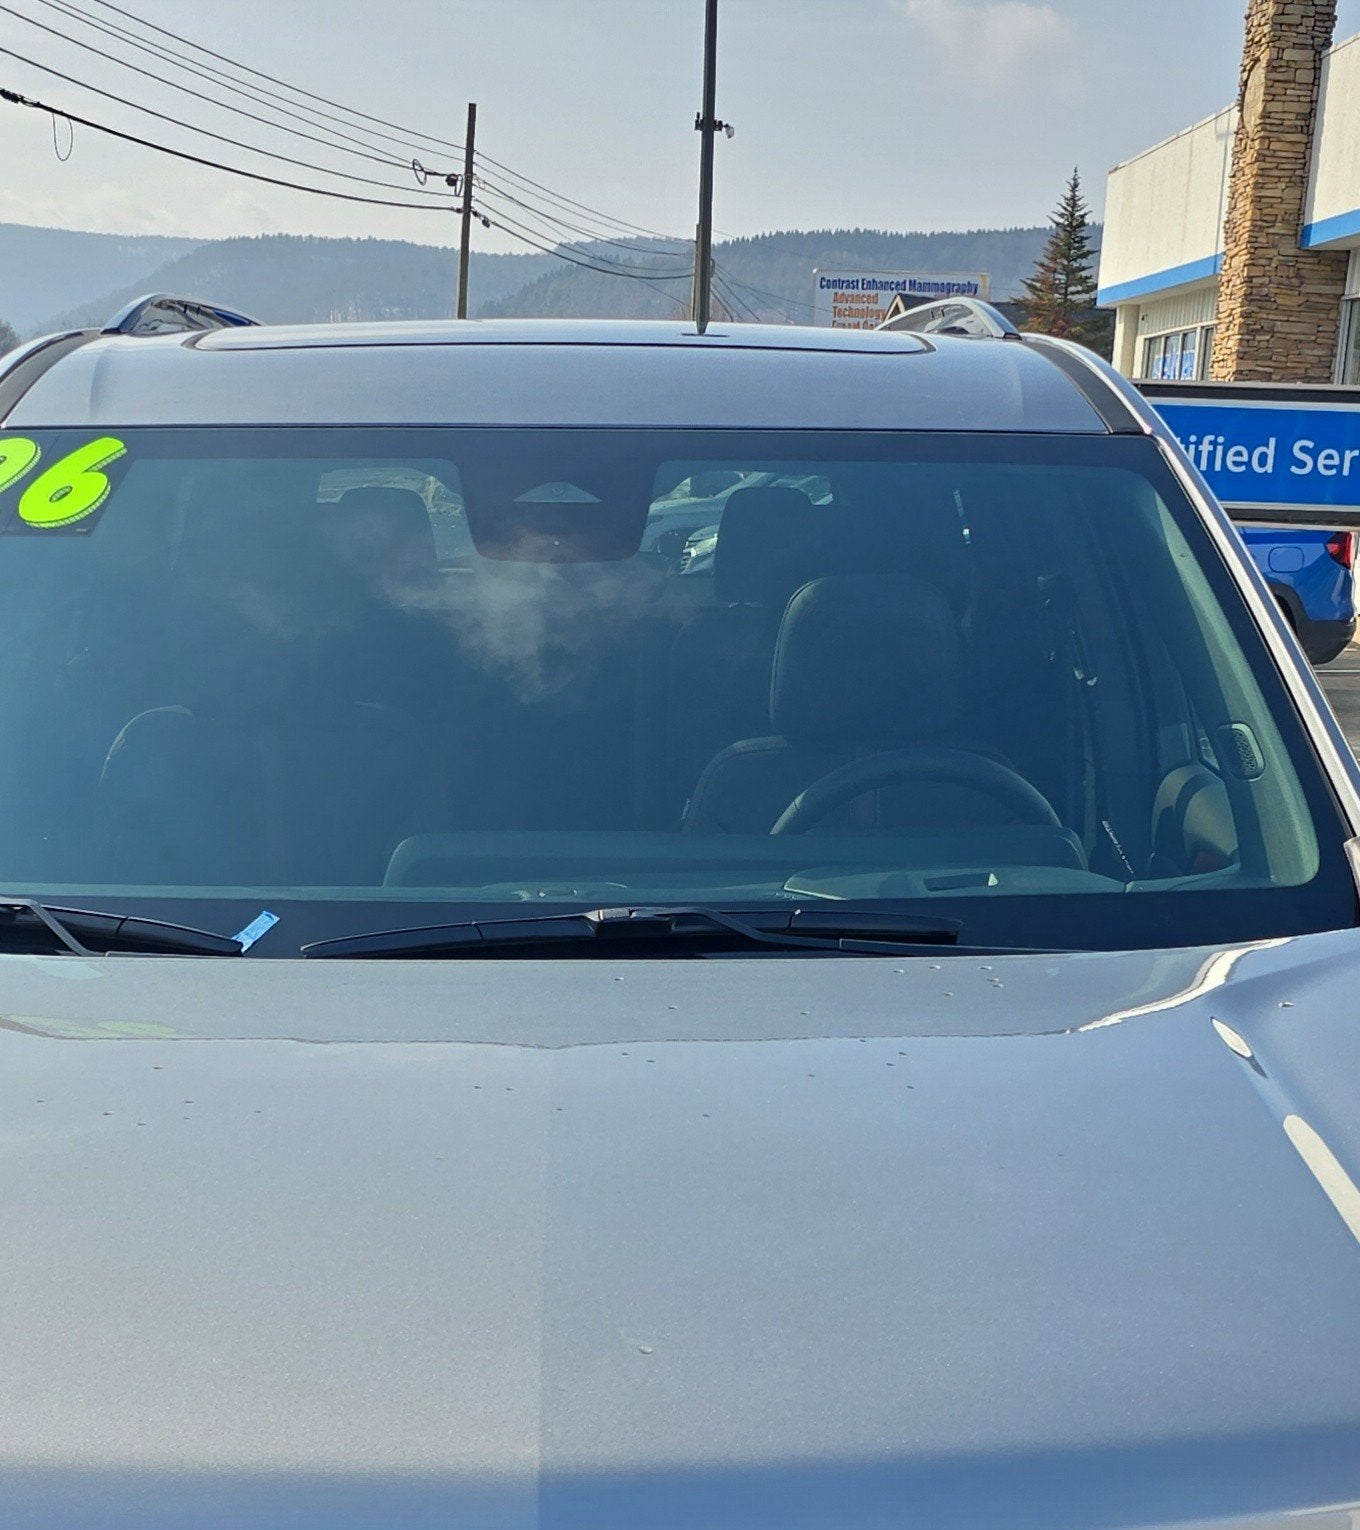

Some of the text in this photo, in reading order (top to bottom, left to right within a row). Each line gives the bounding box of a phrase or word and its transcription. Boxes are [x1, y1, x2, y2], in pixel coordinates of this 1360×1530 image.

[819, 276, 979, 295] Contrast Enhanced Mammography
[833, 292, 879, 304] Advanced
[832, 305, 885, 321] Technology
[1176, 434, 1276, 474] ified
